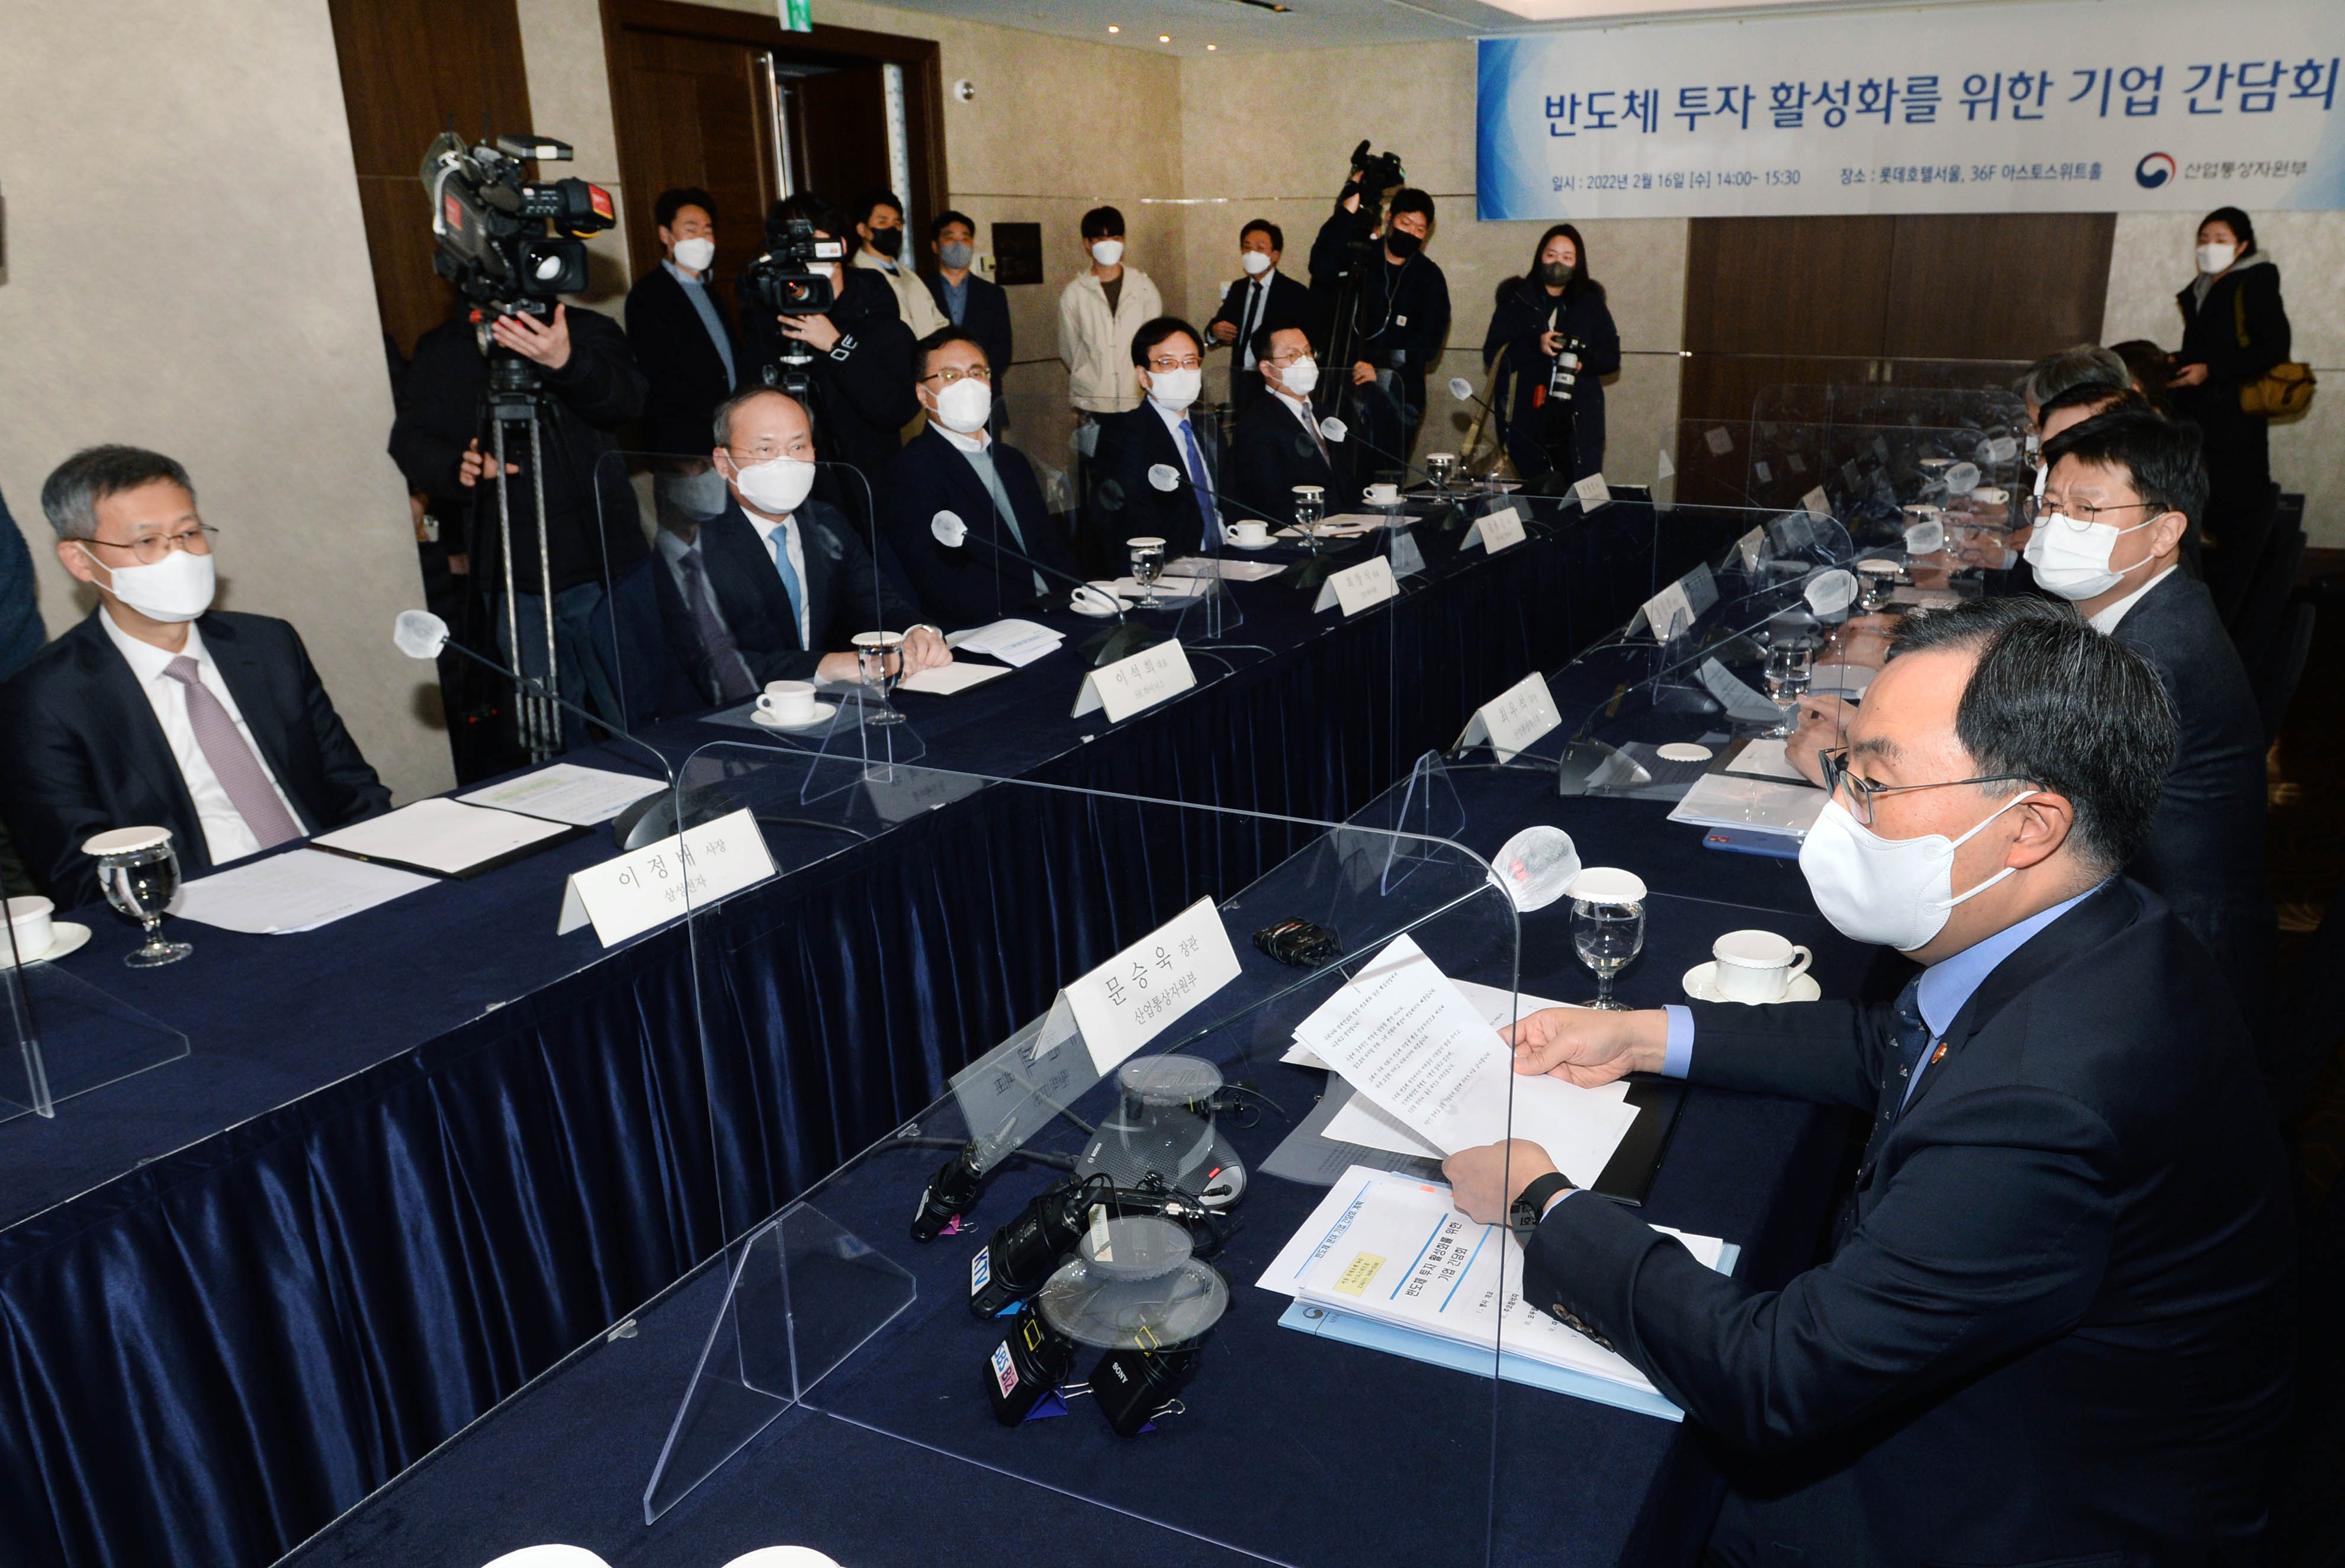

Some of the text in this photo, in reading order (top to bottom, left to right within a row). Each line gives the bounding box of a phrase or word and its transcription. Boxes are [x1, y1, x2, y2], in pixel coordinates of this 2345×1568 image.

[1545, 57, 2341, 137] 반도체 투자 활성화를 위한 기업 간담회
[1552, 176, 1575, 192] 일시
[1587, 174, 1628, 189] 2022년
[1633, 173, 1652, 189] 2월
[1659, 173, 1684, 189] 16일
[1766, 170, 1800, 185] 15:30
[1840, 168, 1865, 185] 장소
[1880, 165, 1964, 184] 롯데호텔서울,
[1971, 165, 1996, 181] 36F
[2002, 162, 2101, 181] 아스토스위트홀
[2185, 160, 2307, 179] 산업통상자원부
[619, 838, 725, 889] 이정배 사장
[1106, 935, 1199, 1006] 문승욱 장관
[1134, 972, 1197, 1026] 산업통상자원부
[1091, 1143, 1102, 1157] BOSCH
[974, 1249, 988, 1286] KTV
[1405, 1222, 1462, 1297] 반도체 투자 활성화를 위한
[1438, 1247, 1468, 1281] 기업 간담회
[995, 1345, 1008, 1372] SBS
[1113, 1362, 1127, 1383] SONY
